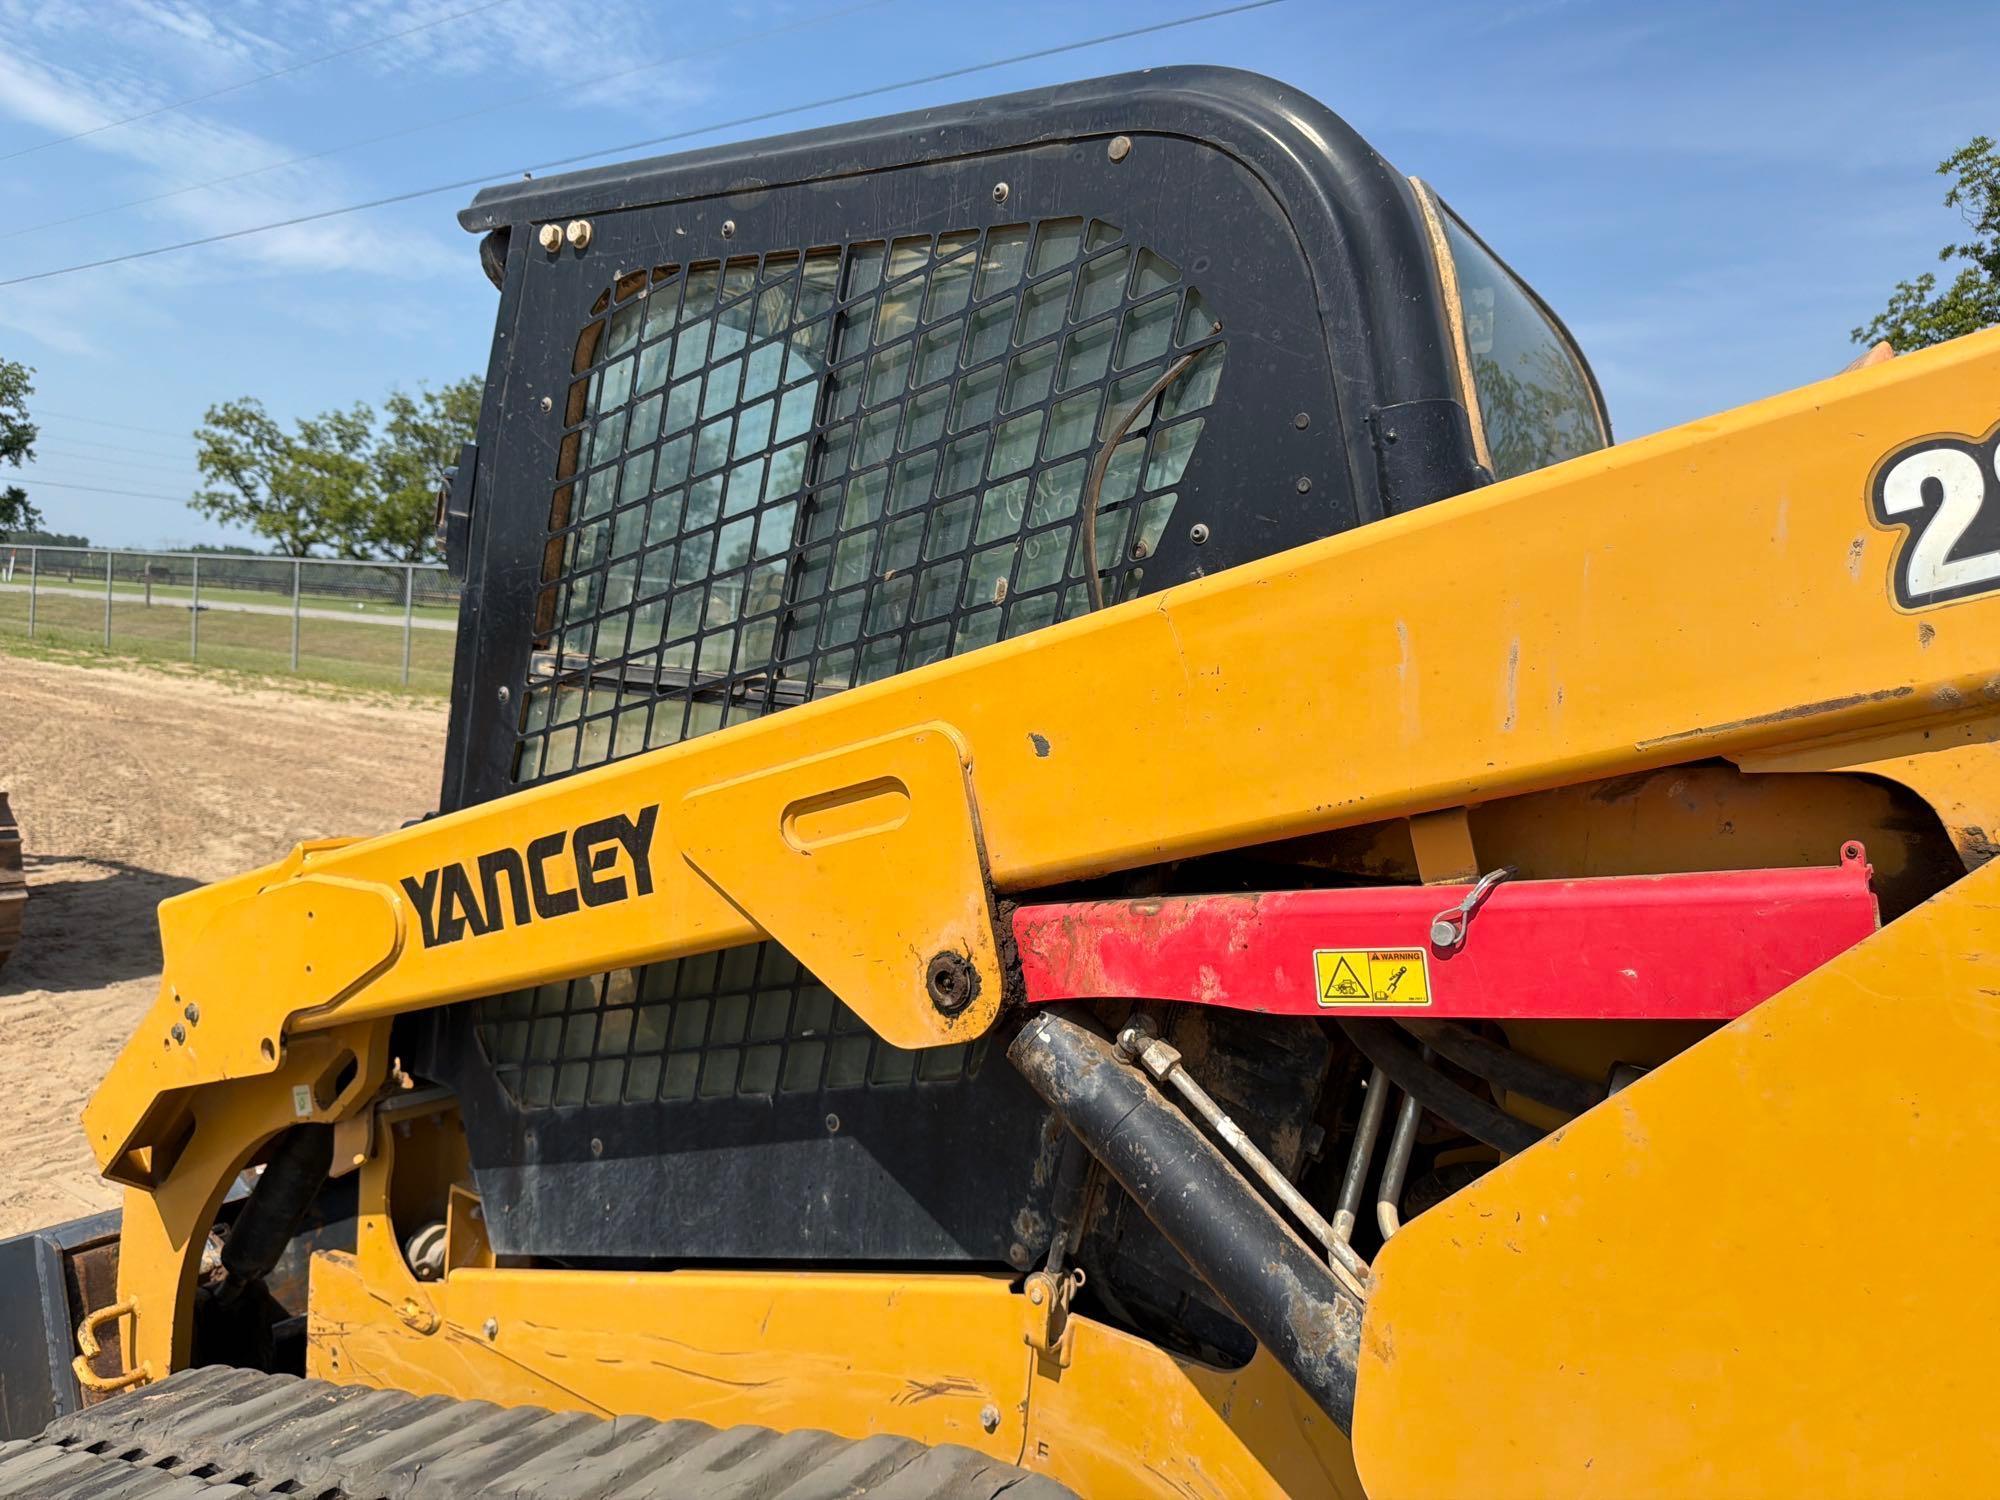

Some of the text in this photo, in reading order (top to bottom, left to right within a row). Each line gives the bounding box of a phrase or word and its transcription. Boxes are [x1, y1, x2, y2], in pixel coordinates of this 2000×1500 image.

[1882, 442, 2000, 599] 2
[399, 803, 661, 950] YANCEY
[1380, 952, 1421, 961] WARNING
